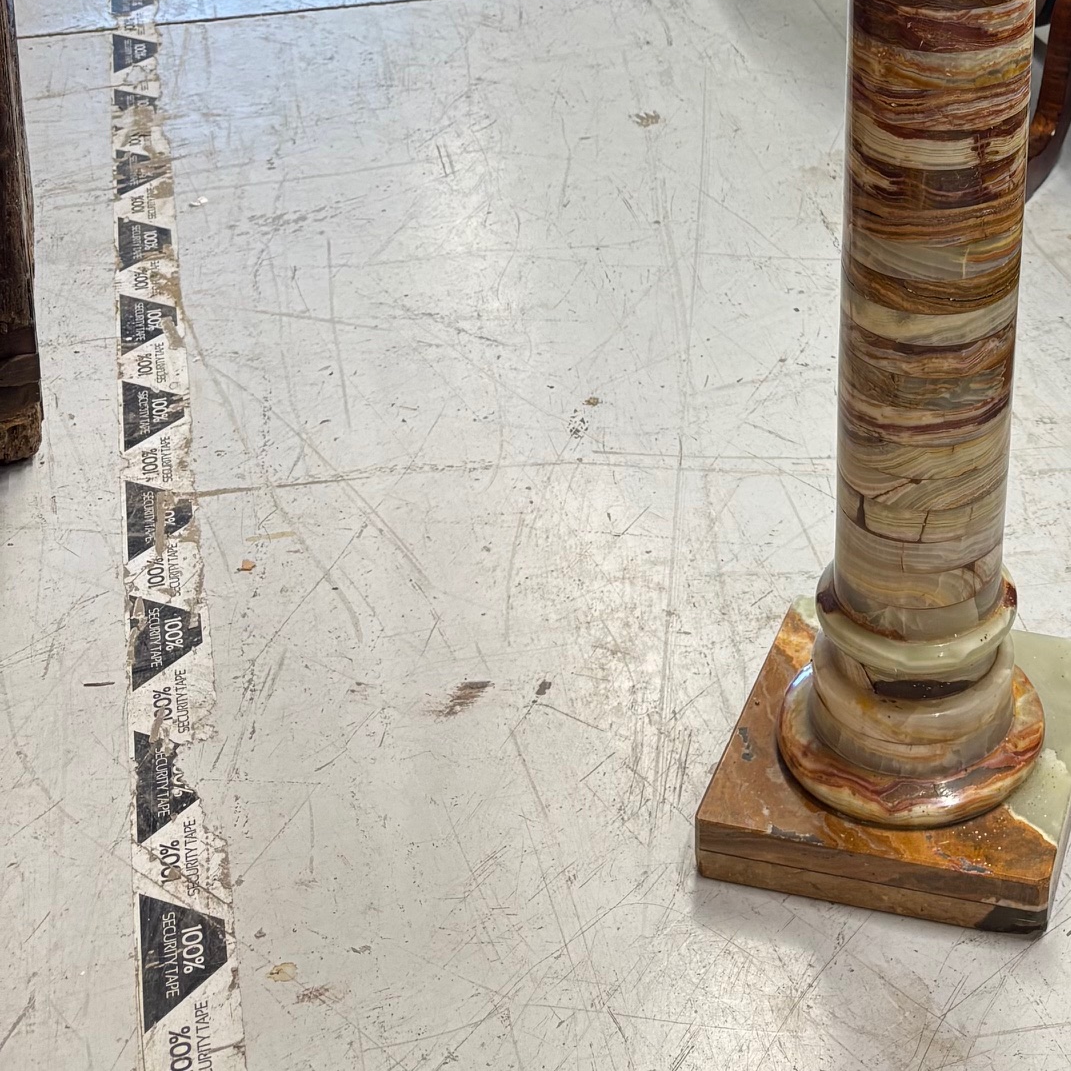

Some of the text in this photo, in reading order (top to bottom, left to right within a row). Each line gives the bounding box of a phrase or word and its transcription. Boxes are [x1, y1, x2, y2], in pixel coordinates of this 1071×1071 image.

[137, 353, 153, 376] 100%
[151, 397, 168, 423] 100%
[142, 448, 159, 475] 100%
[160, 436, 173, 483] SECURITY TAPE
[146, 557, 166, 589] 100%
[167, 543, 179, 562] TAPE
[148, 608, 163, 668] SECURITY TAPE
[164, 616, 184, 651] 100%
[174, 669, 190, 733] SECURITY TAPE
[157, 791, 171, 818] TAPE
[183, 819, 200, 897] SECURITY TAPE
[162, 912, 180, 999] SECURITY TAPE
[181, 924, 205, 974] 100%
[169, 1026, 193, 1071] 00%
[195, 1000, 213, 1071] URITY TAPE
